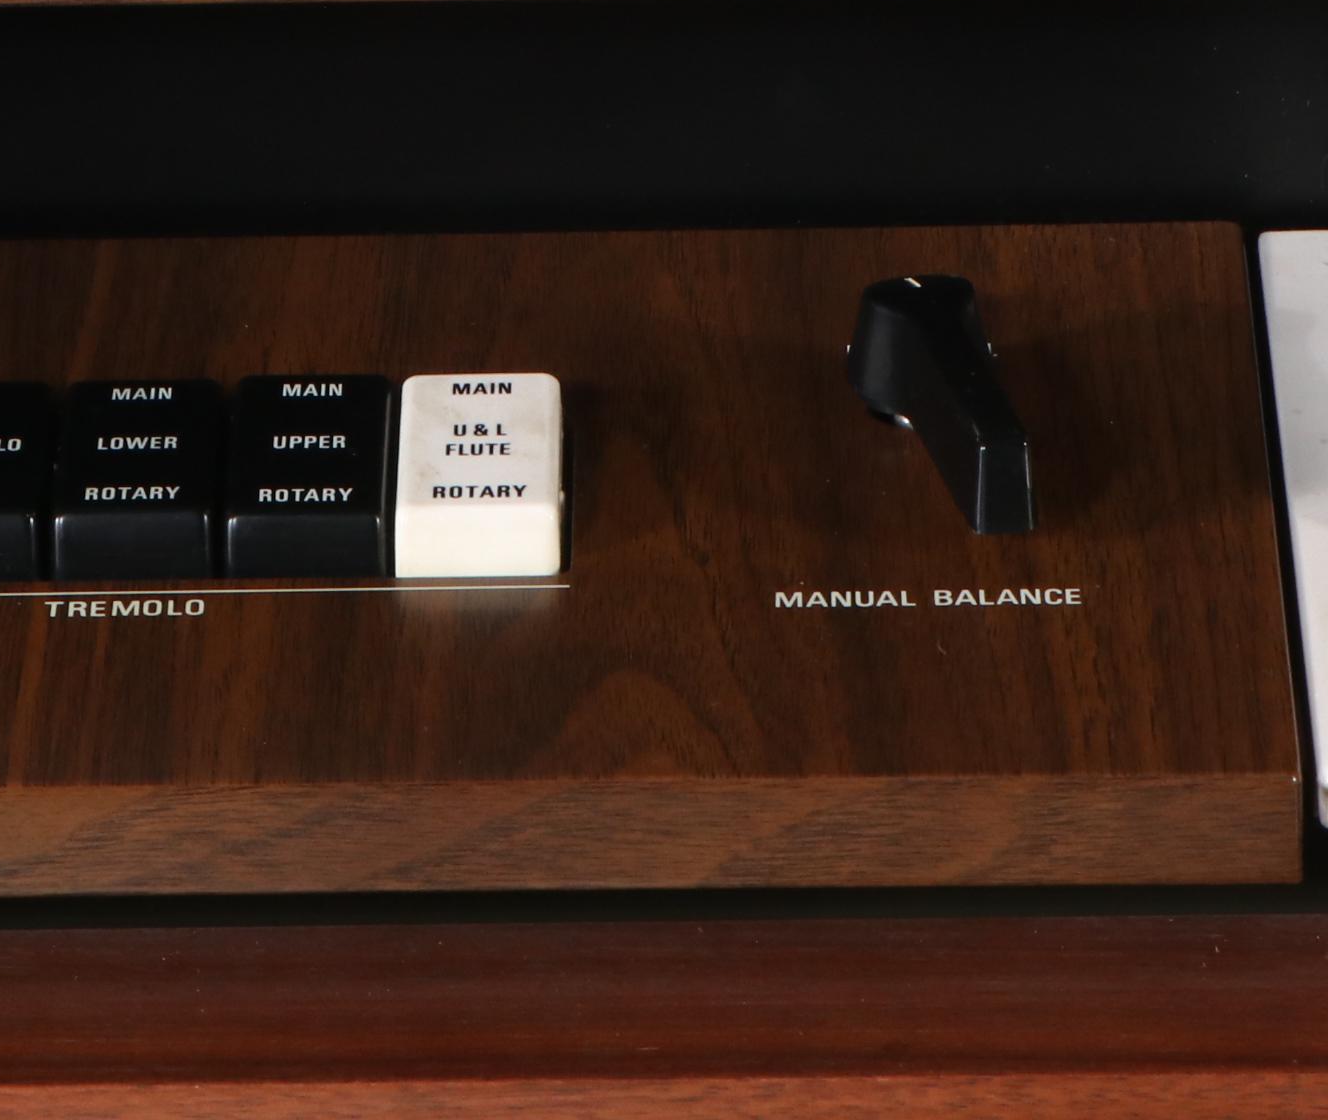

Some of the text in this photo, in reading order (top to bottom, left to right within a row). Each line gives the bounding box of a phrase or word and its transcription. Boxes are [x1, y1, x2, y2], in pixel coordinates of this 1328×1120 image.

[112, 387, 173, 400] MAIN
[282, 383, 343, 397] MAIN
[452, 382, 512, 396] MAIN
[453, 423, 507, 437] U & L
[97, 436, 178, 451] LOWER
[272, 435, 346, 450] UPPER
[445, 443, 511, 457] FLUTE
[84, 486, 180, 501] ROTARY
[258, 488, 353, 503] ROTARY
[432, 484, 527, 499] ROTARY
[774, 588, 1082, 609] MANUAL BALANCE
[45, 600, 206, 618] TREMOLO
